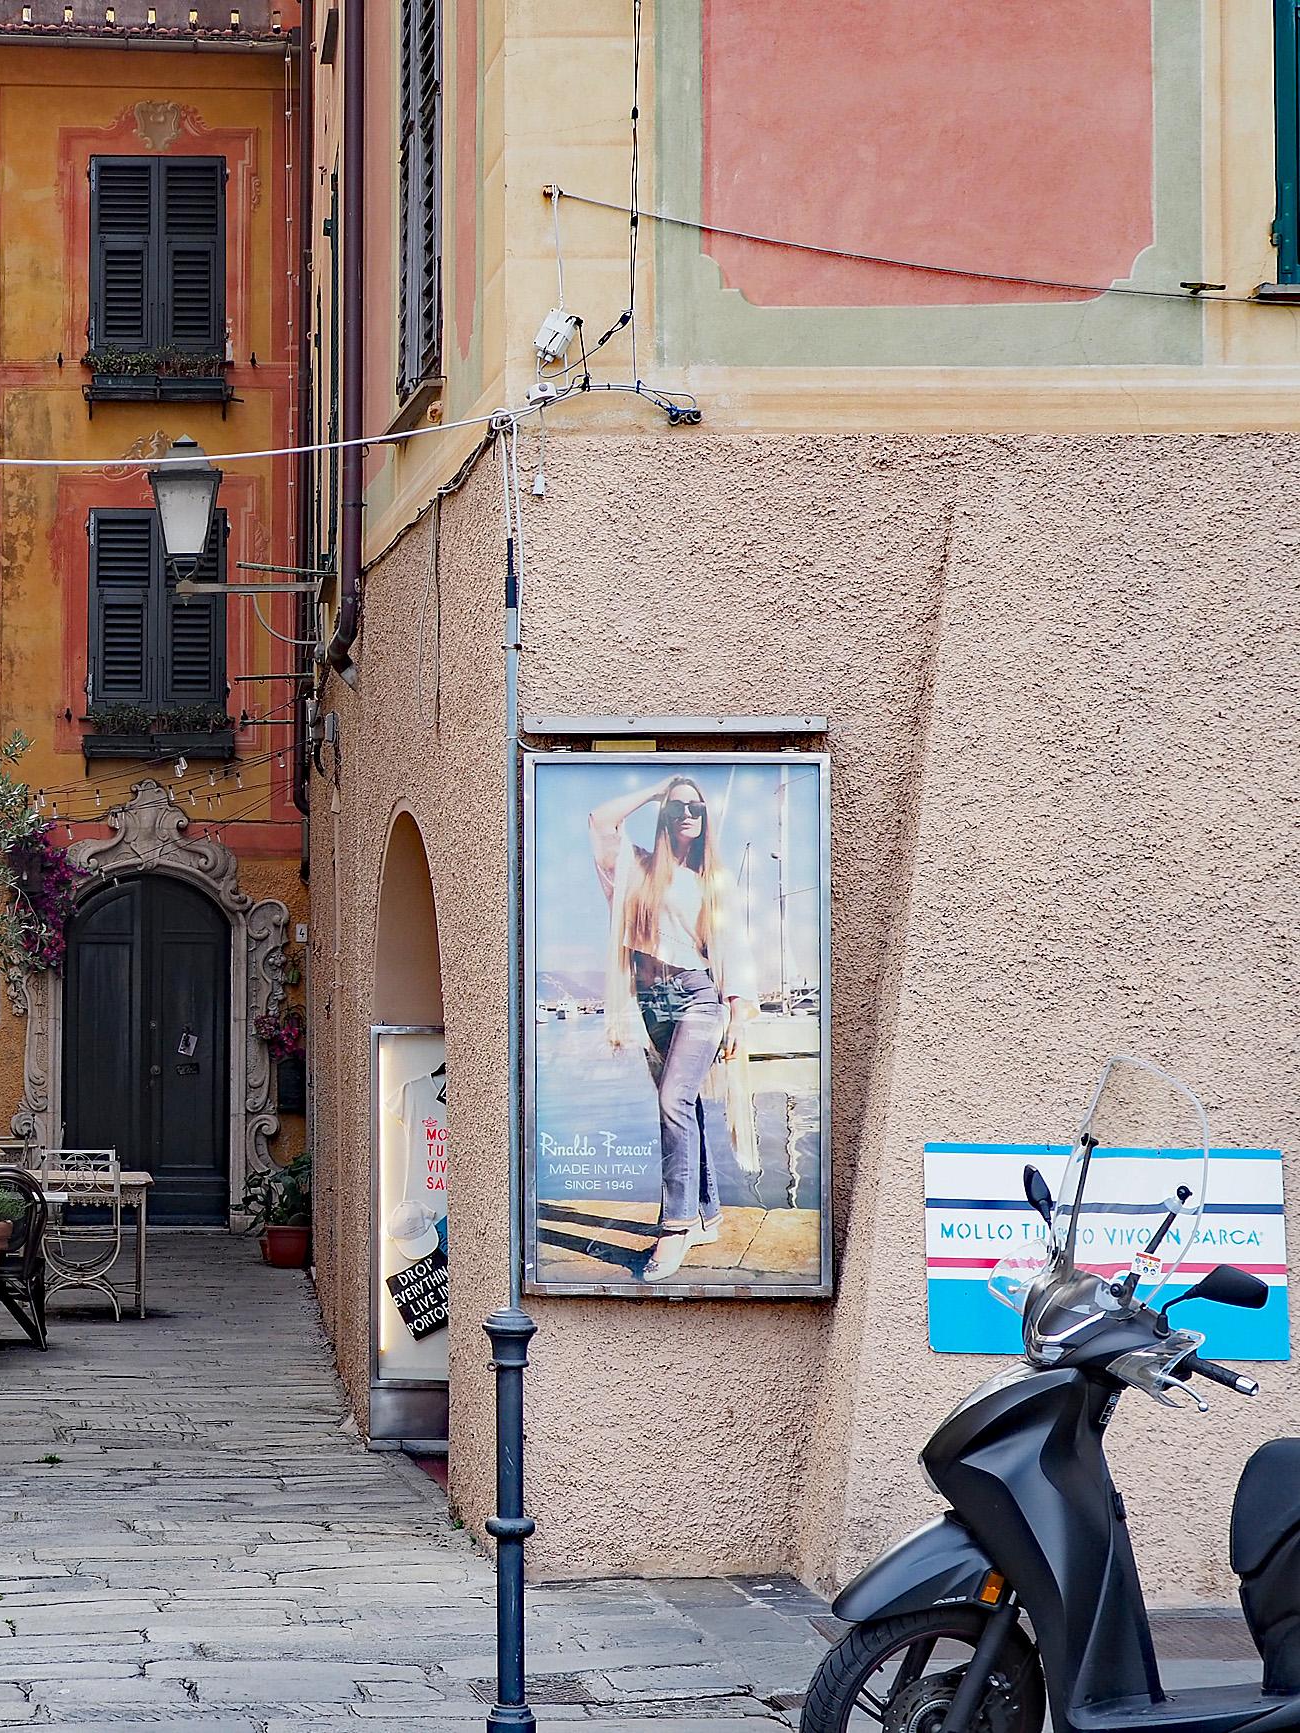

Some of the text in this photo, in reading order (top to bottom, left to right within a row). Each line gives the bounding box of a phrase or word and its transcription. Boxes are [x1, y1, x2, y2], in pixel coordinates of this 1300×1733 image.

[299, 928, 305, 938] 4
[540, 1132, 597, 1156] Rinaldo
[549, 1164, 648, 1175] MADE IN ITALY
[564, 1181, 634, 1190] SINCE 1946
[940, 1222, 1013, 1240] MOLLO
[1103, 1227, 1152, 1246] VIVO
[397, 1257, 434, 1288] DROP
[409, 1291, 439, 1317] LIVE
